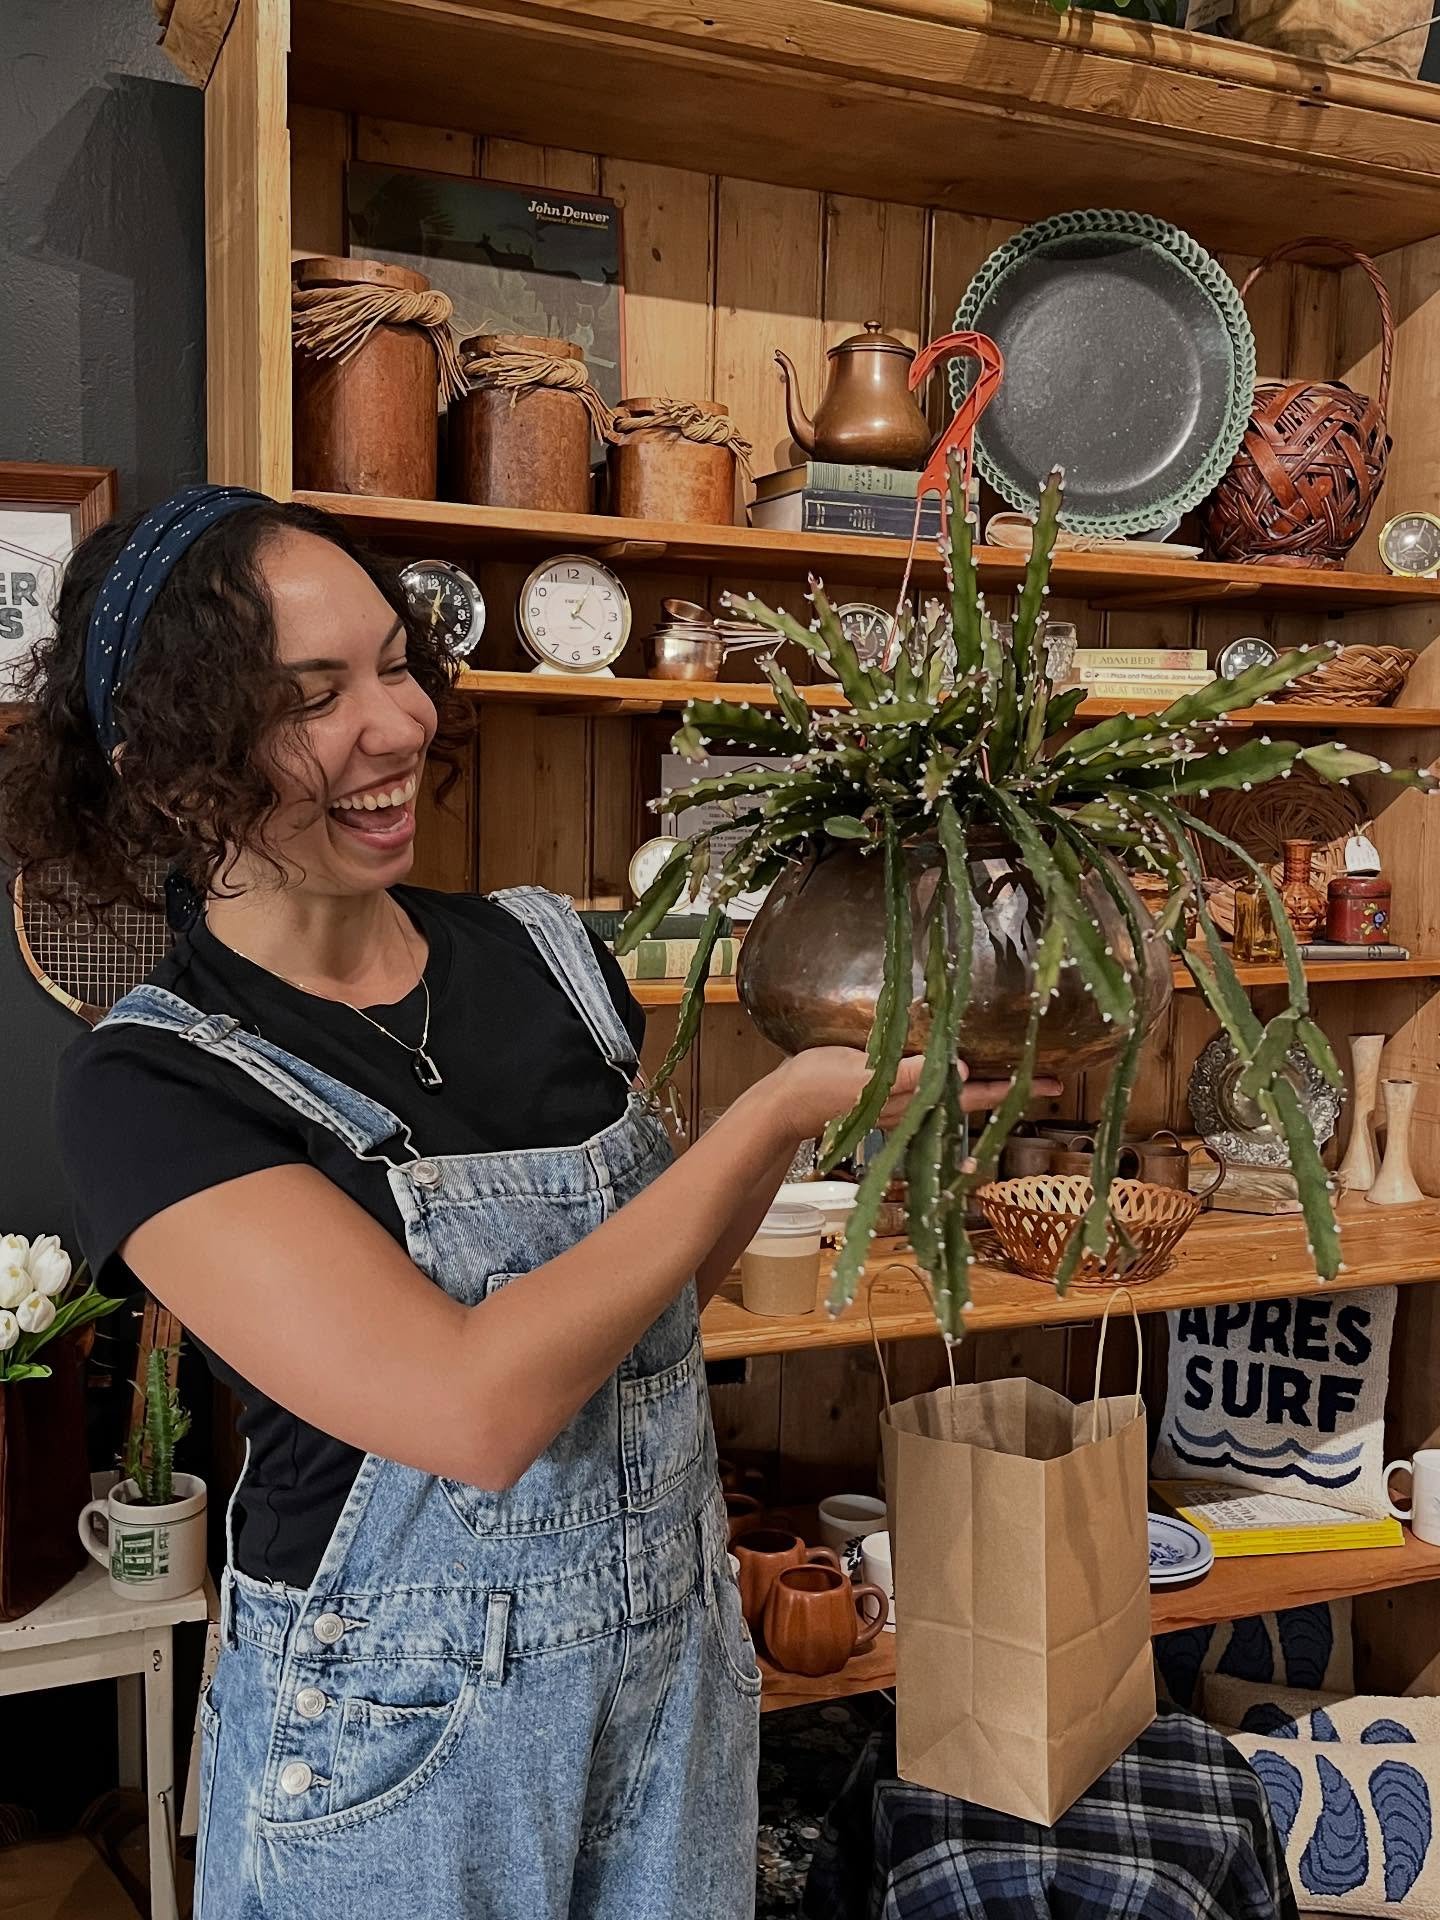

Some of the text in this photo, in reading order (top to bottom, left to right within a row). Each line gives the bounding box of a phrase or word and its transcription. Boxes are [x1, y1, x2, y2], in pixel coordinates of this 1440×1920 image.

[527, 200, 610, 222] John Denver
[550, 573, 558, 583] 11
[567, 568, 580, 580] 12
[535, 587, 547, 597] 10
[602, 590, 612, 601] 2
[453, 594, 462, 607] 2
[457, 609, 467, 621] 3
[530, 607, 540, 617] 9
[607, 612, 618, 622] 3
[452, 622, 463, 635] 4
[536, 627, 546, 636] 8
[603, 631, 613, 641] 4
[551, 643, 560, 654] 7
[592, 645, 601, 656] 5
[571, 650, 581, 661] 6
[1100, 656, 1156, 665] ADAM BEDE
[1178, 1297, 1373, 1367] APRES
[1184, 1354, 1364, 1433] SURF
